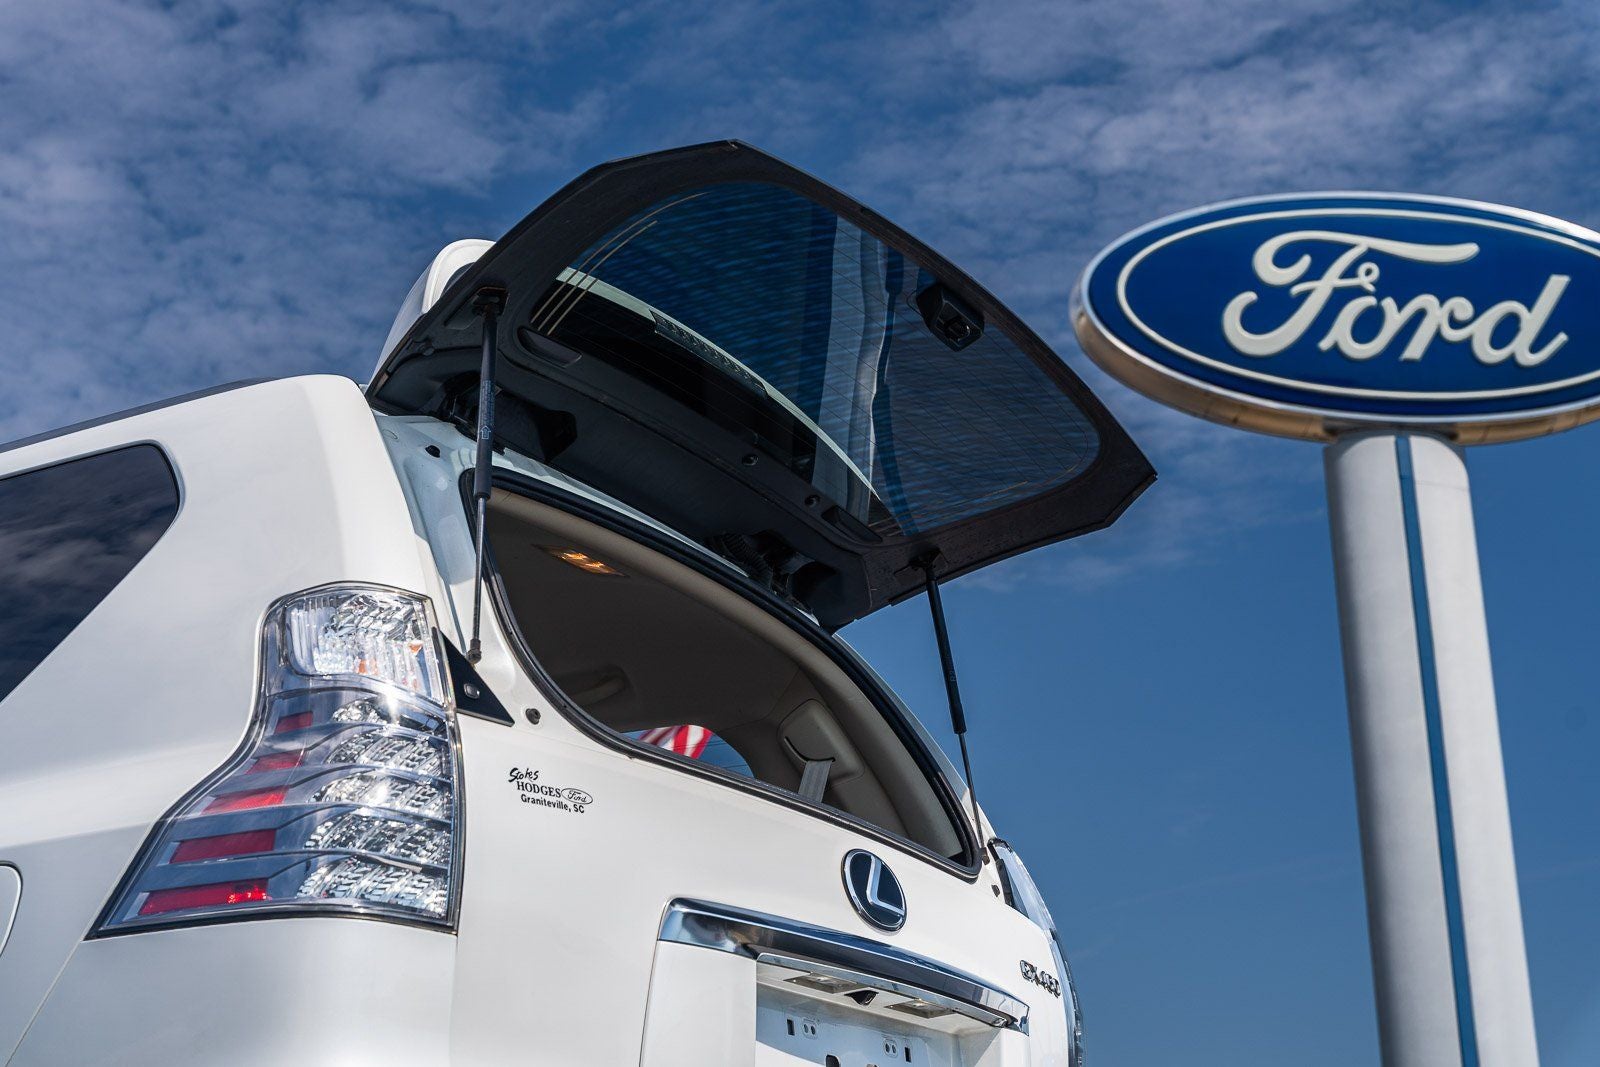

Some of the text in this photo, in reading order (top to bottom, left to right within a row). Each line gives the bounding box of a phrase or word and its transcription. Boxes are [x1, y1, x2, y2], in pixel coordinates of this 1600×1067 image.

[1222, 230, 1571, 367] Ford
[508, 767, 540, 783] Stokes
[516, 781, 587, 803] HODGES Ford
[521, 793, 585, 813] Graniteville, SC
